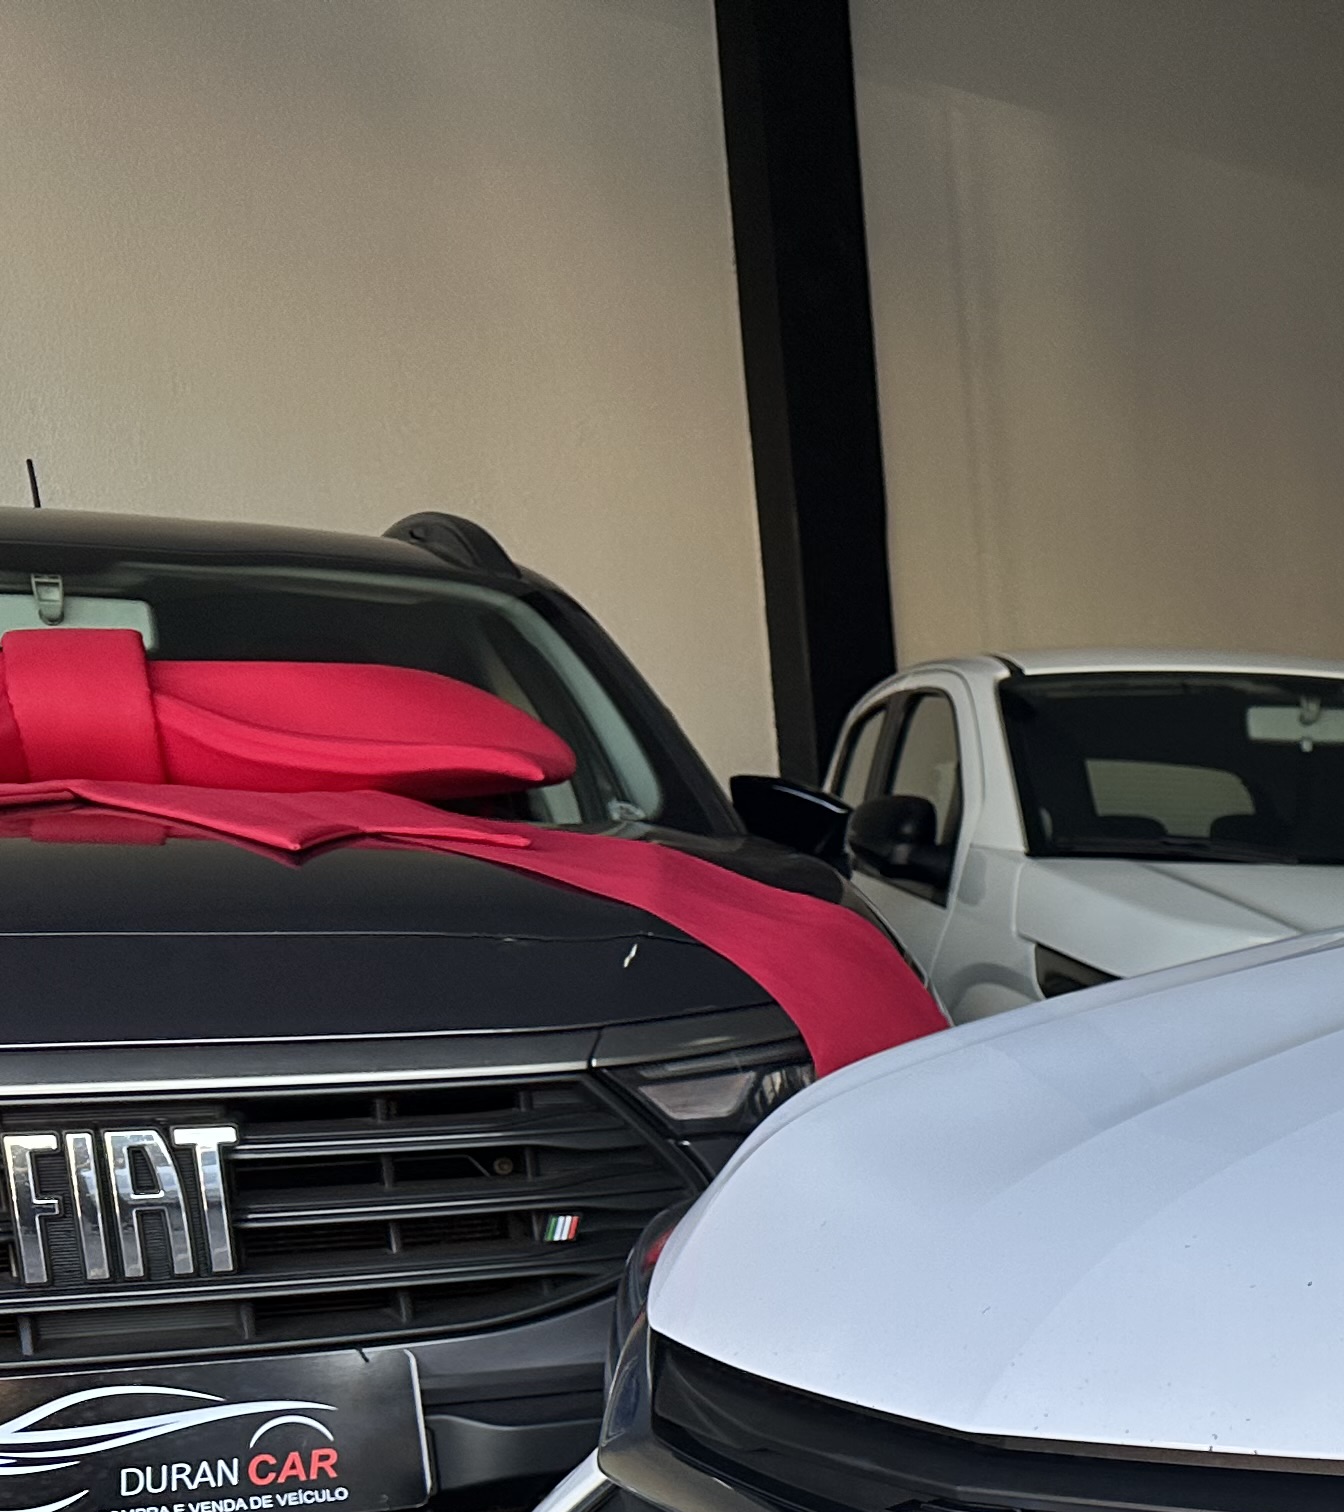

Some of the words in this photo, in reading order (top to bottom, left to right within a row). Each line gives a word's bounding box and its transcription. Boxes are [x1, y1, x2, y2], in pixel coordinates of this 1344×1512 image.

[2, 1125, 238, 1284] FIAT
[119, 1457, 239, 1497] DURAN
[247, 1447, 338, 1486] CAR
[249, 1494, 274, 1511] DE
[275, 1486, 349, 1508] VEÍCULO
